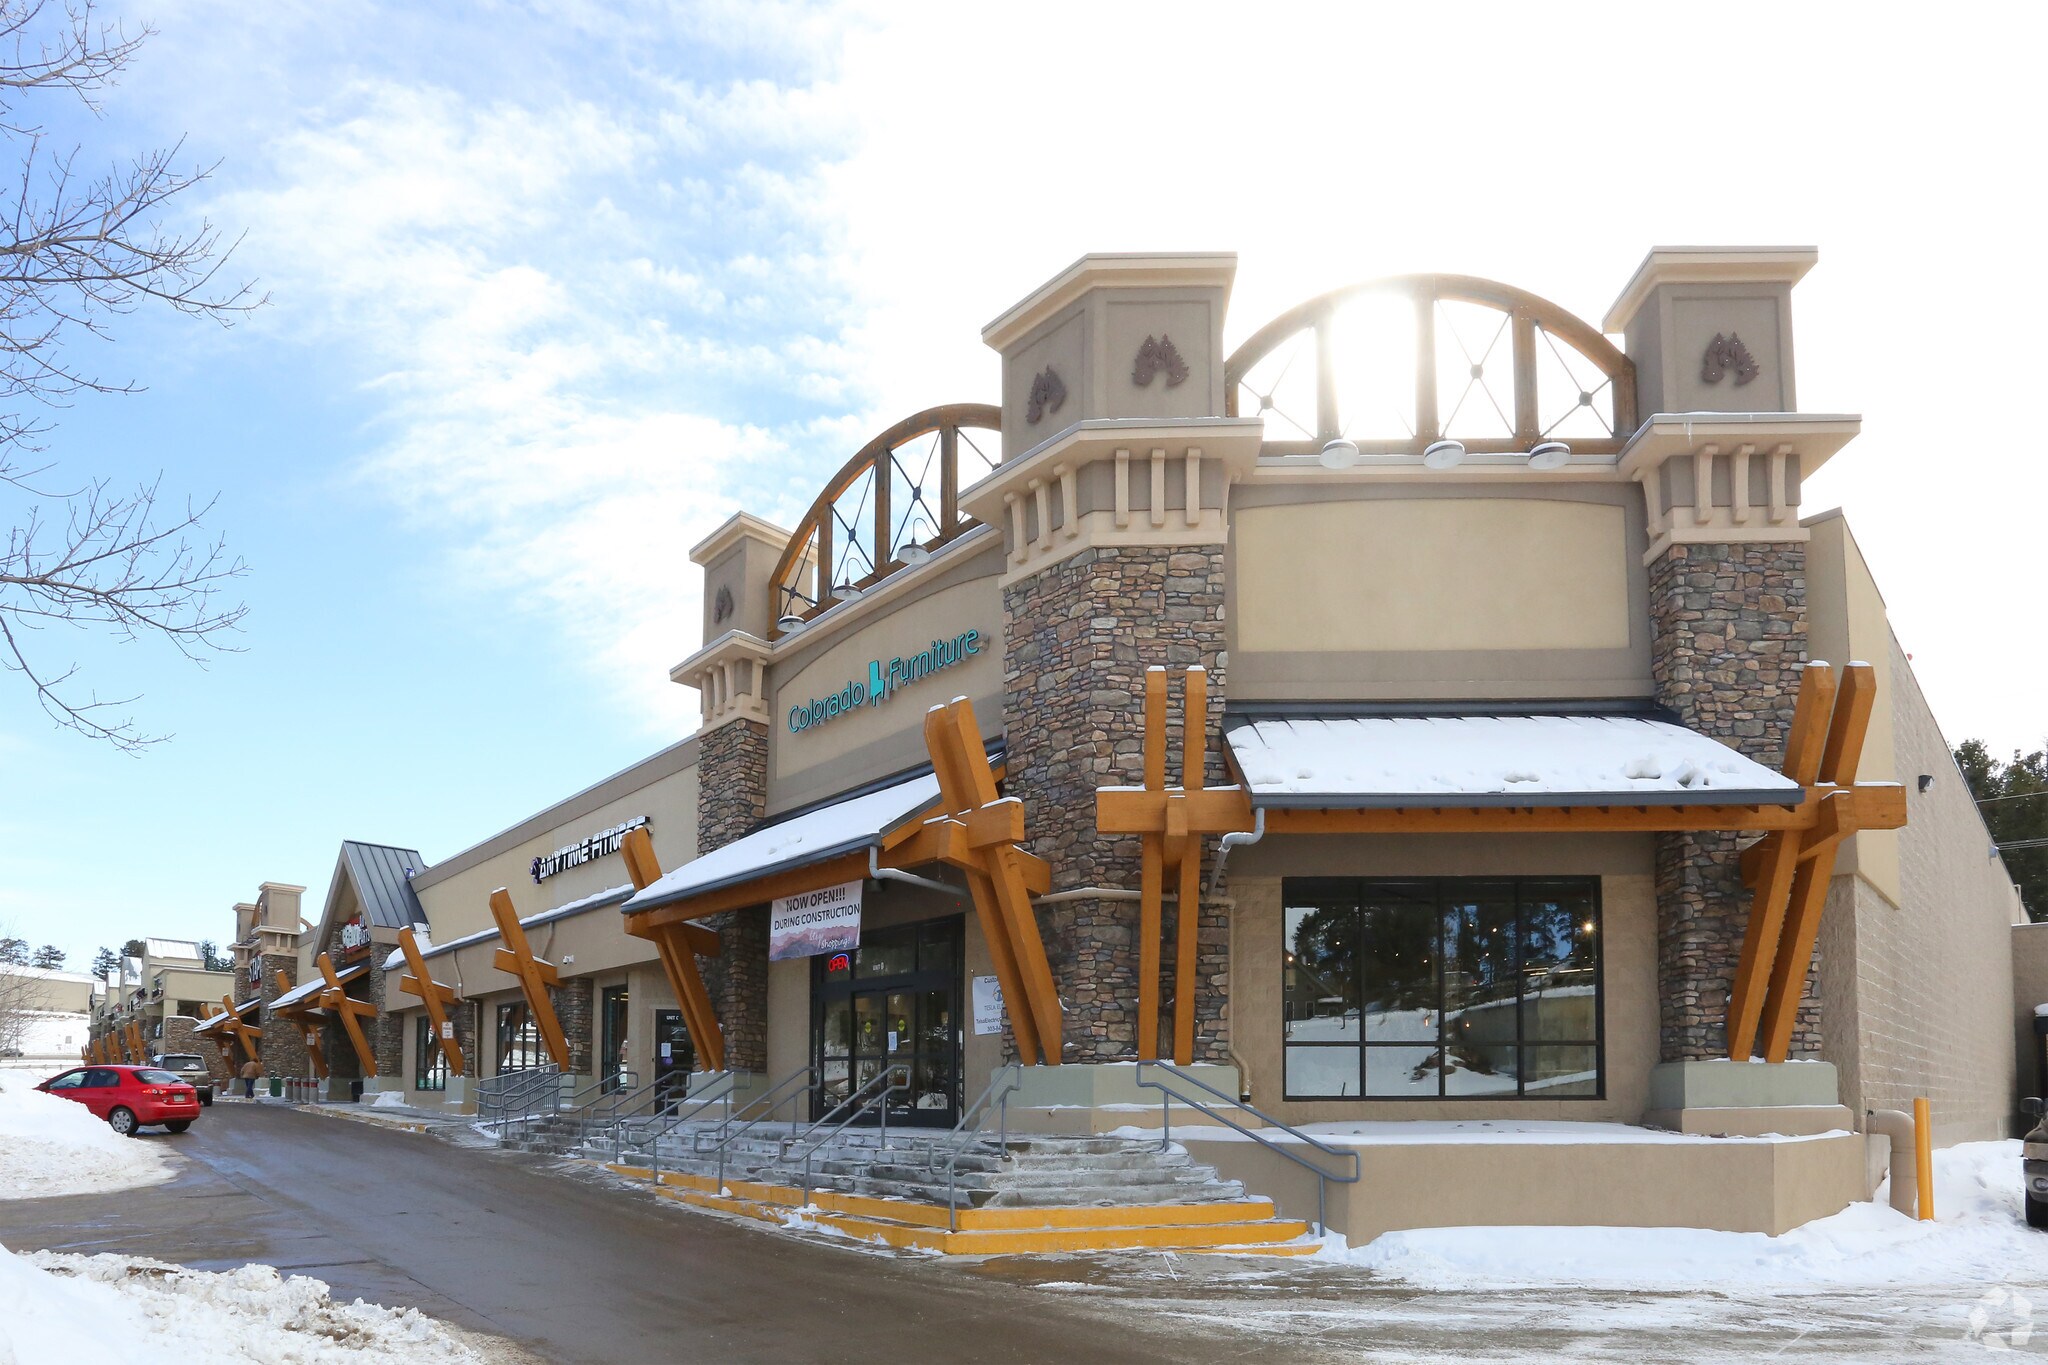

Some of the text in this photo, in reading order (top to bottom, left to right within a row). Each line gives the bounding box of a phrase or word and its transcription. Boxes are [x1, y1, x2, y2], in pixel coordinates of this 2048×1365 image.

[788, 629, 979, 734] Colorado Furniture
[540, 817, 647, 879] ANYTIME FITNE
[786, 887, 846, 912] NOW OPEN!!!
[774, 903, 860, 930] DURING CONSTRUCTION
[828, 956, 848, 973] OPEN
